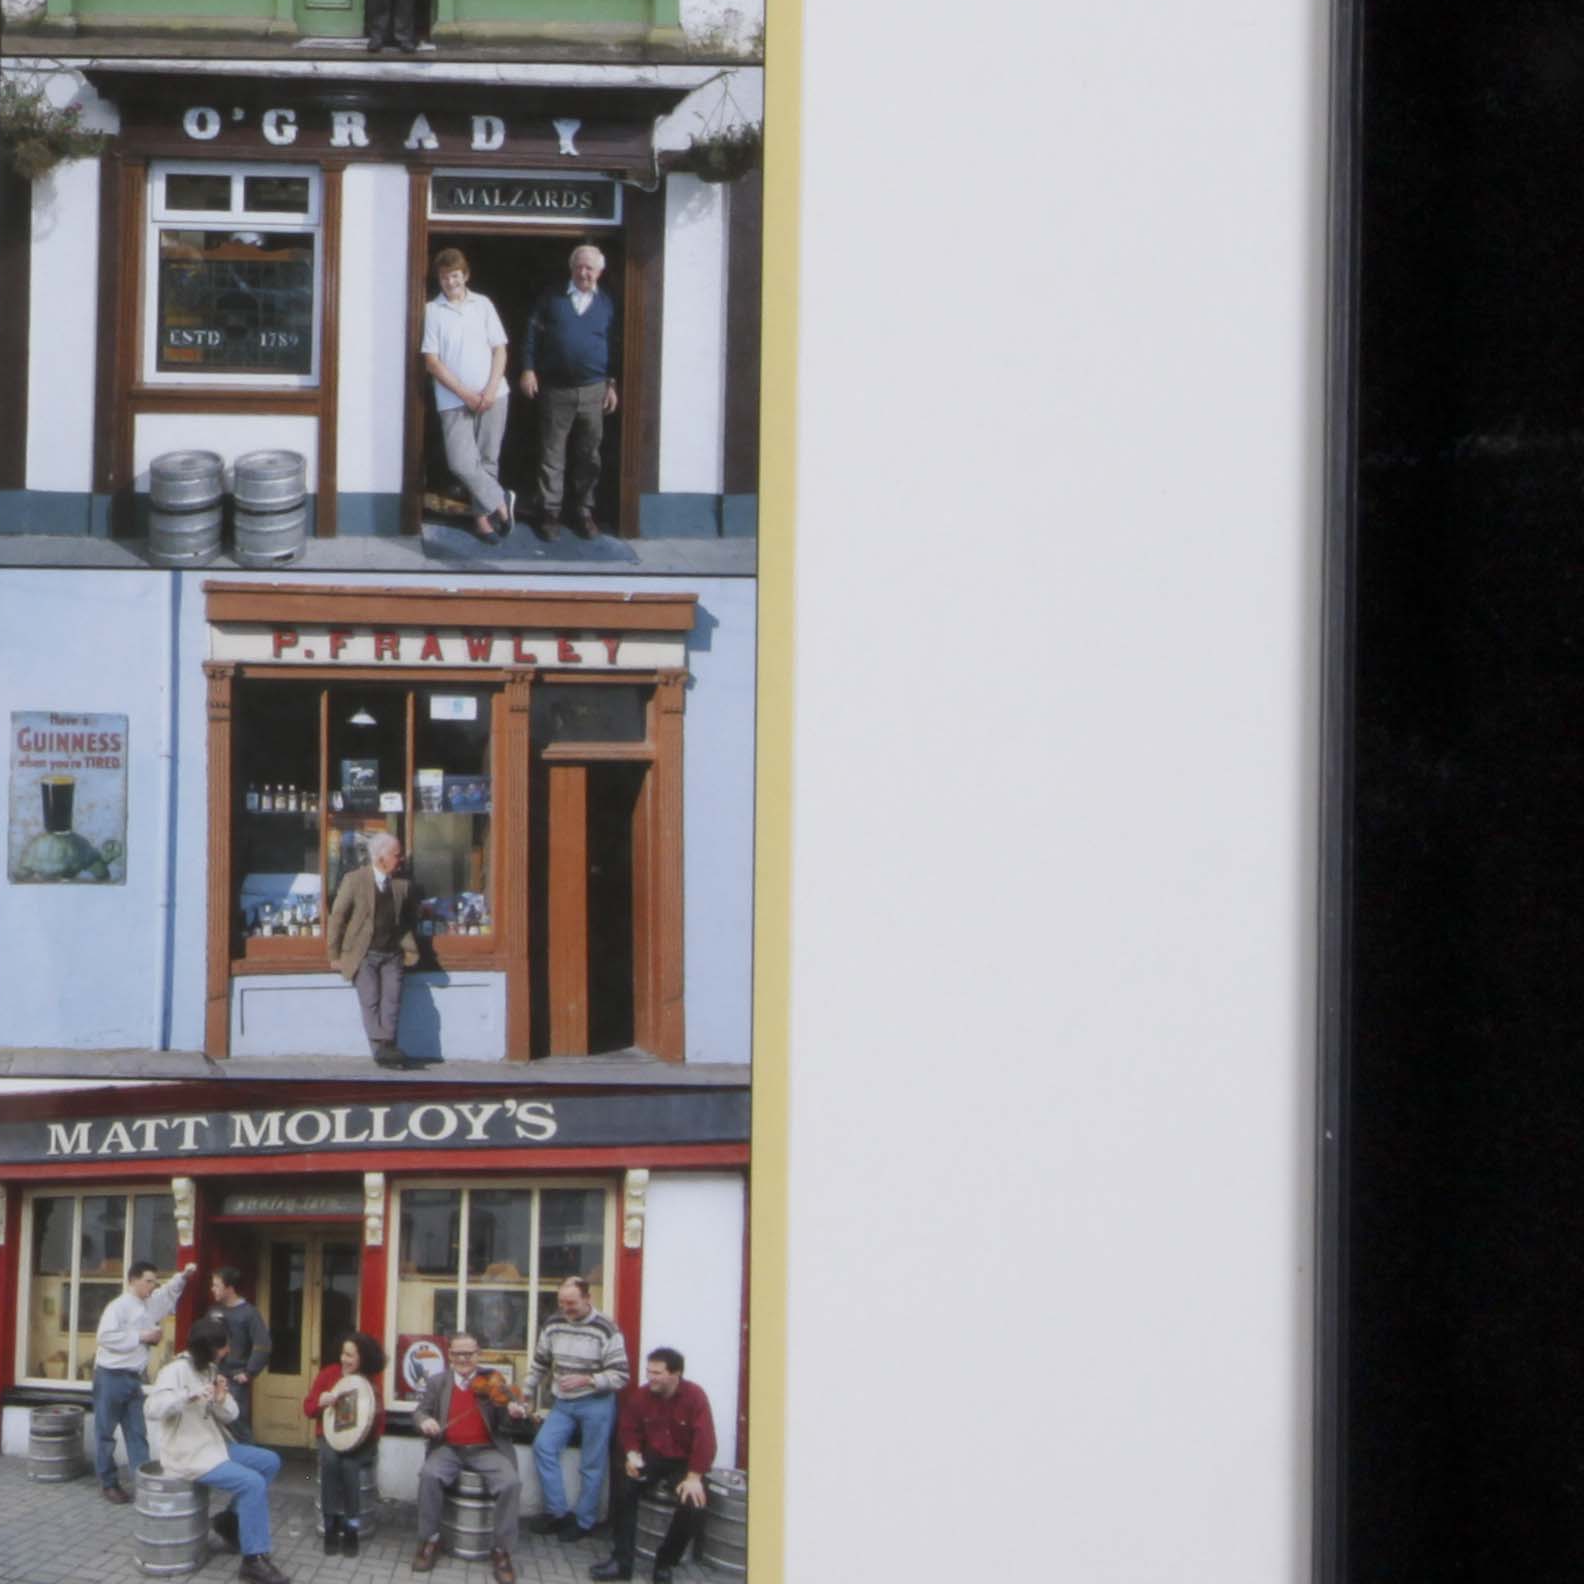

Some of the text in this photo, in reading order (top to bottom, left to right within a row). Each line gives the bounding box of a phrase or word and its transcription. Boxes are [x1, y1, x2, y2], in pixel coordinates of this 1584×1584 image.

[182, 106, 581, 156] O'GRADY
[453, 187, 594, 210] MALZARDS
[17, 726, 121, 752] GUINNESS
[85, 757, 121, 768] TIRED
[48, 1100, 558, 1156] MATT MOLLOY'S
